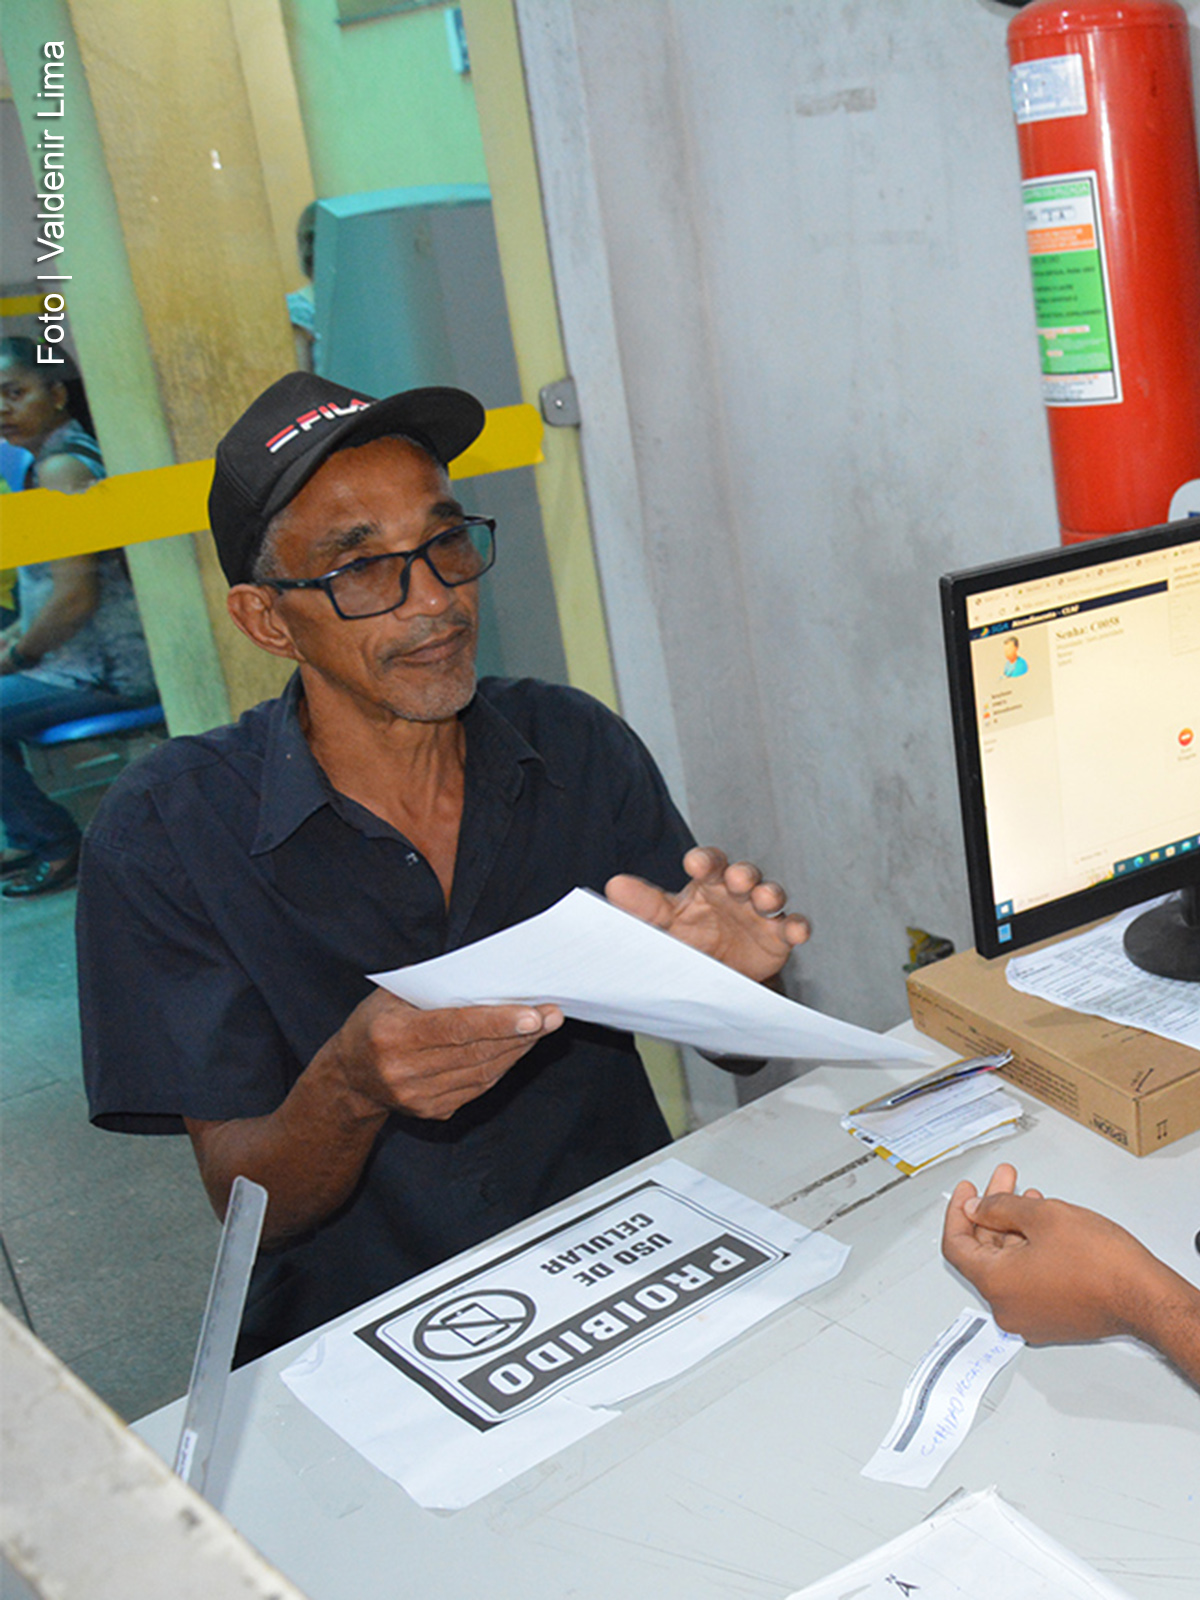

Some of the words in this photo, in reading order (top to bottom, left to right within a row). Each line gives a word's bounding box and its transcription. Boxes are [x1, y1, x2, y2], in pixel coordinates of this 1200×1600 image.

[540, 1213, 654, 1275] CELULAR
[612, 1233, 673, 1265] USO
[572, 1262, 615, 1287] DE
[488, 1245, 747, 1395] PROIBIDO
